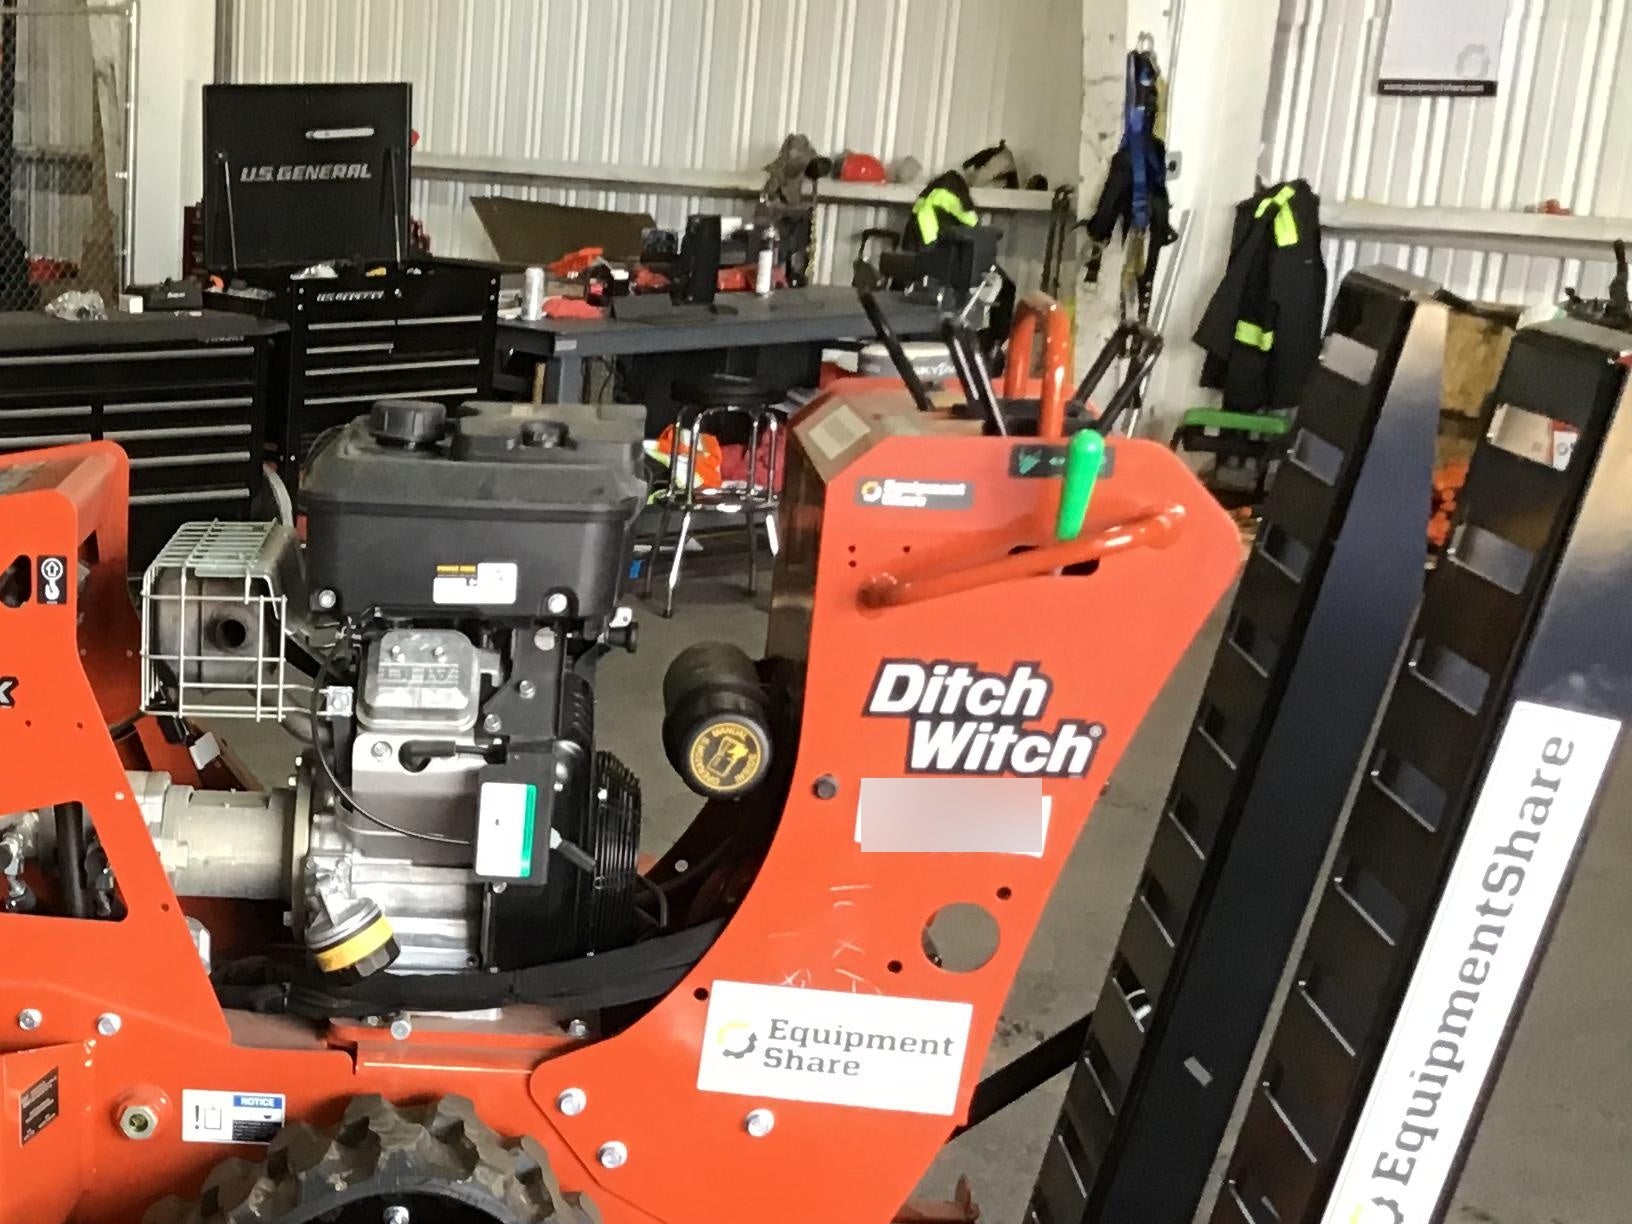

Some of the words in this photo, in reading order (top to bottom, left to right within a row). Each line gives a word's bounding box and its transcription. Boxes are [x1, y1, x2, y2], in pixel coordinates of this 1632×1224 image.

[276, 163, 372, 181] GENERAL
[869, 663, 1048, 717] Ditch
[1371, 736, 1575, 1186] EquipmentShare
[768, 1018, 955, 1057] Equipment
[763, 1046, 861, 1077] Share
[241, 1096, 275, 1108] NOTICE
